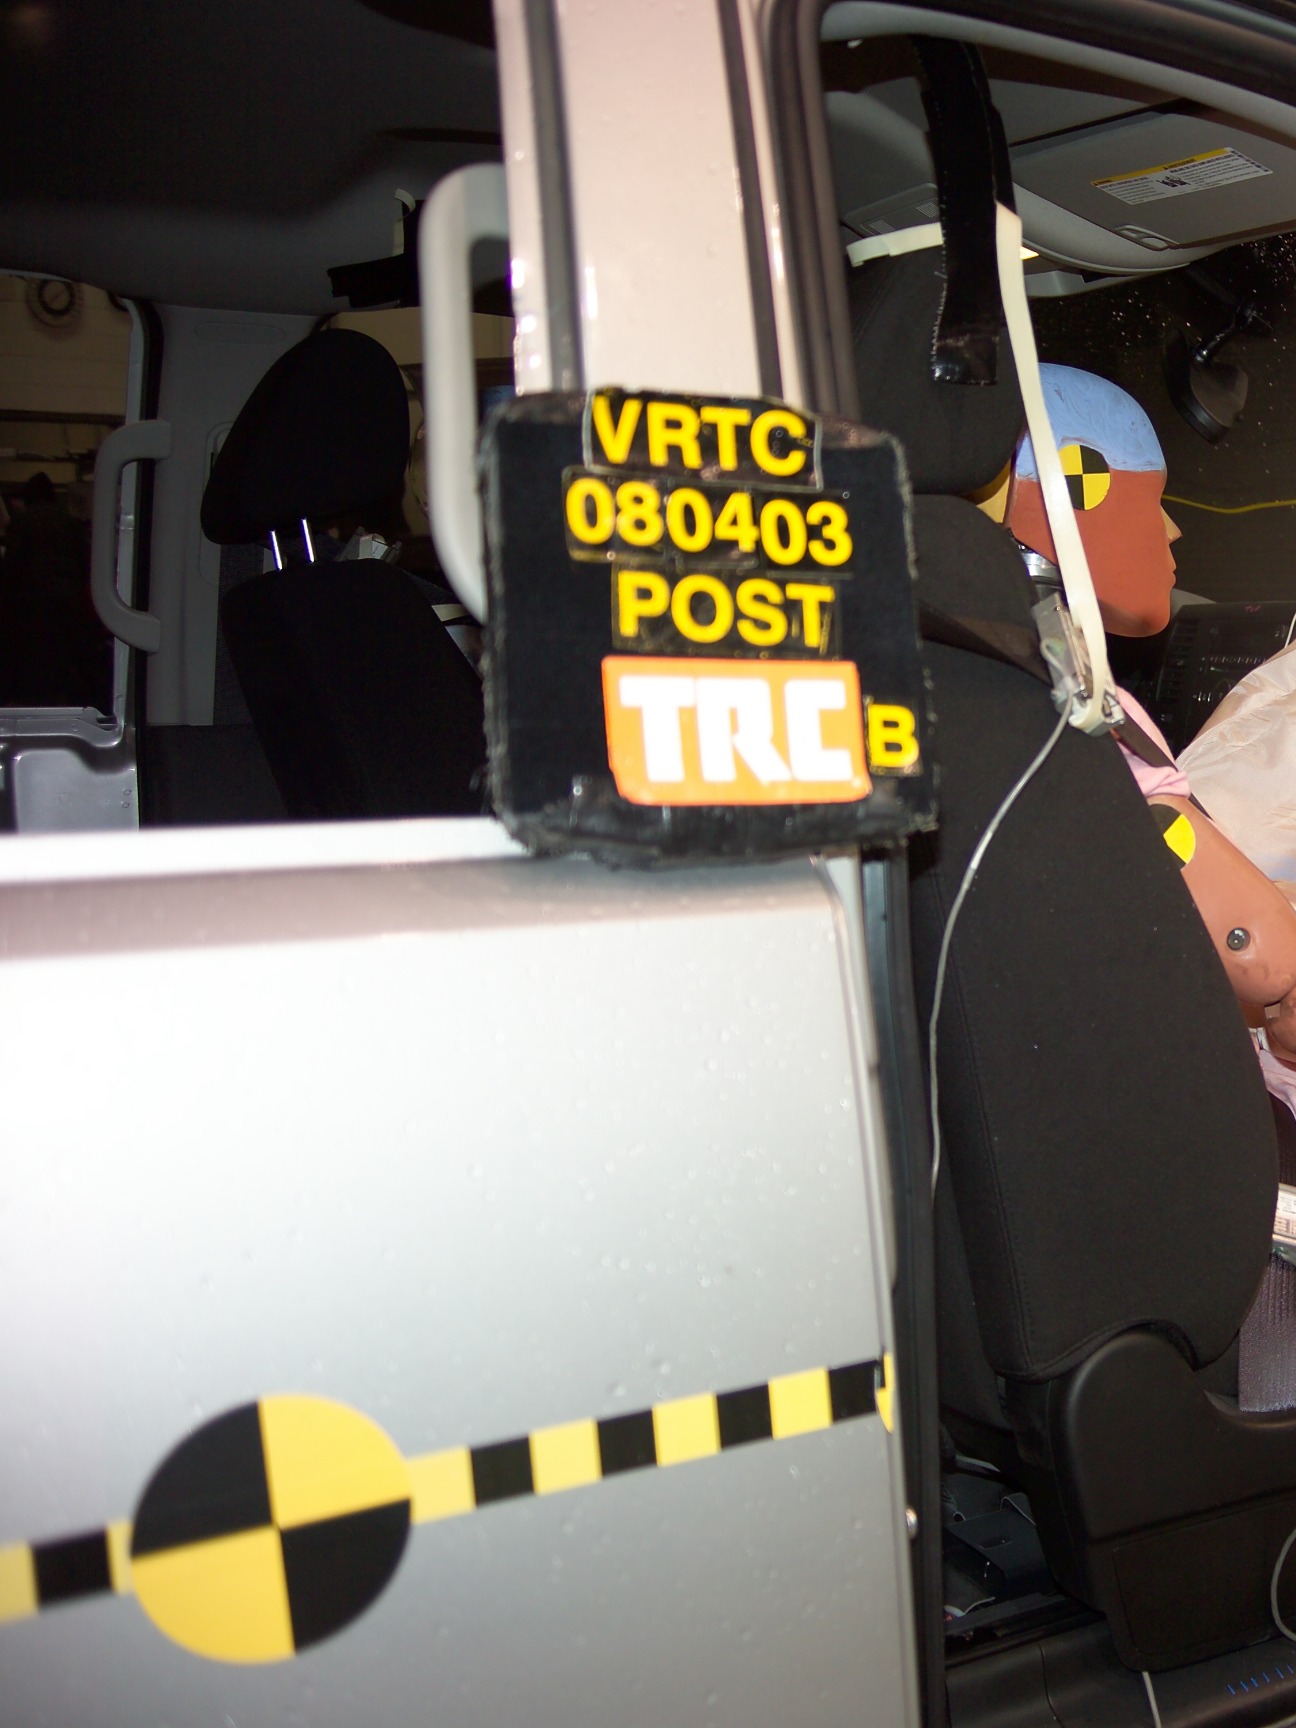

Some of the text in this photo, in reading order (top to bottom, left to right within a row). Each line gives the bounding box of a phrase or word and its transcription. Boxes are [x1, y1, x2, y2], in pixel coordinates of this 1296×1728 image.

[592, 395, 808, 477] VRTC
[565, 477, 853, 567] 080403
[616, 569, 835, 649] POST
[618, 674, 920, 784] TRC B
